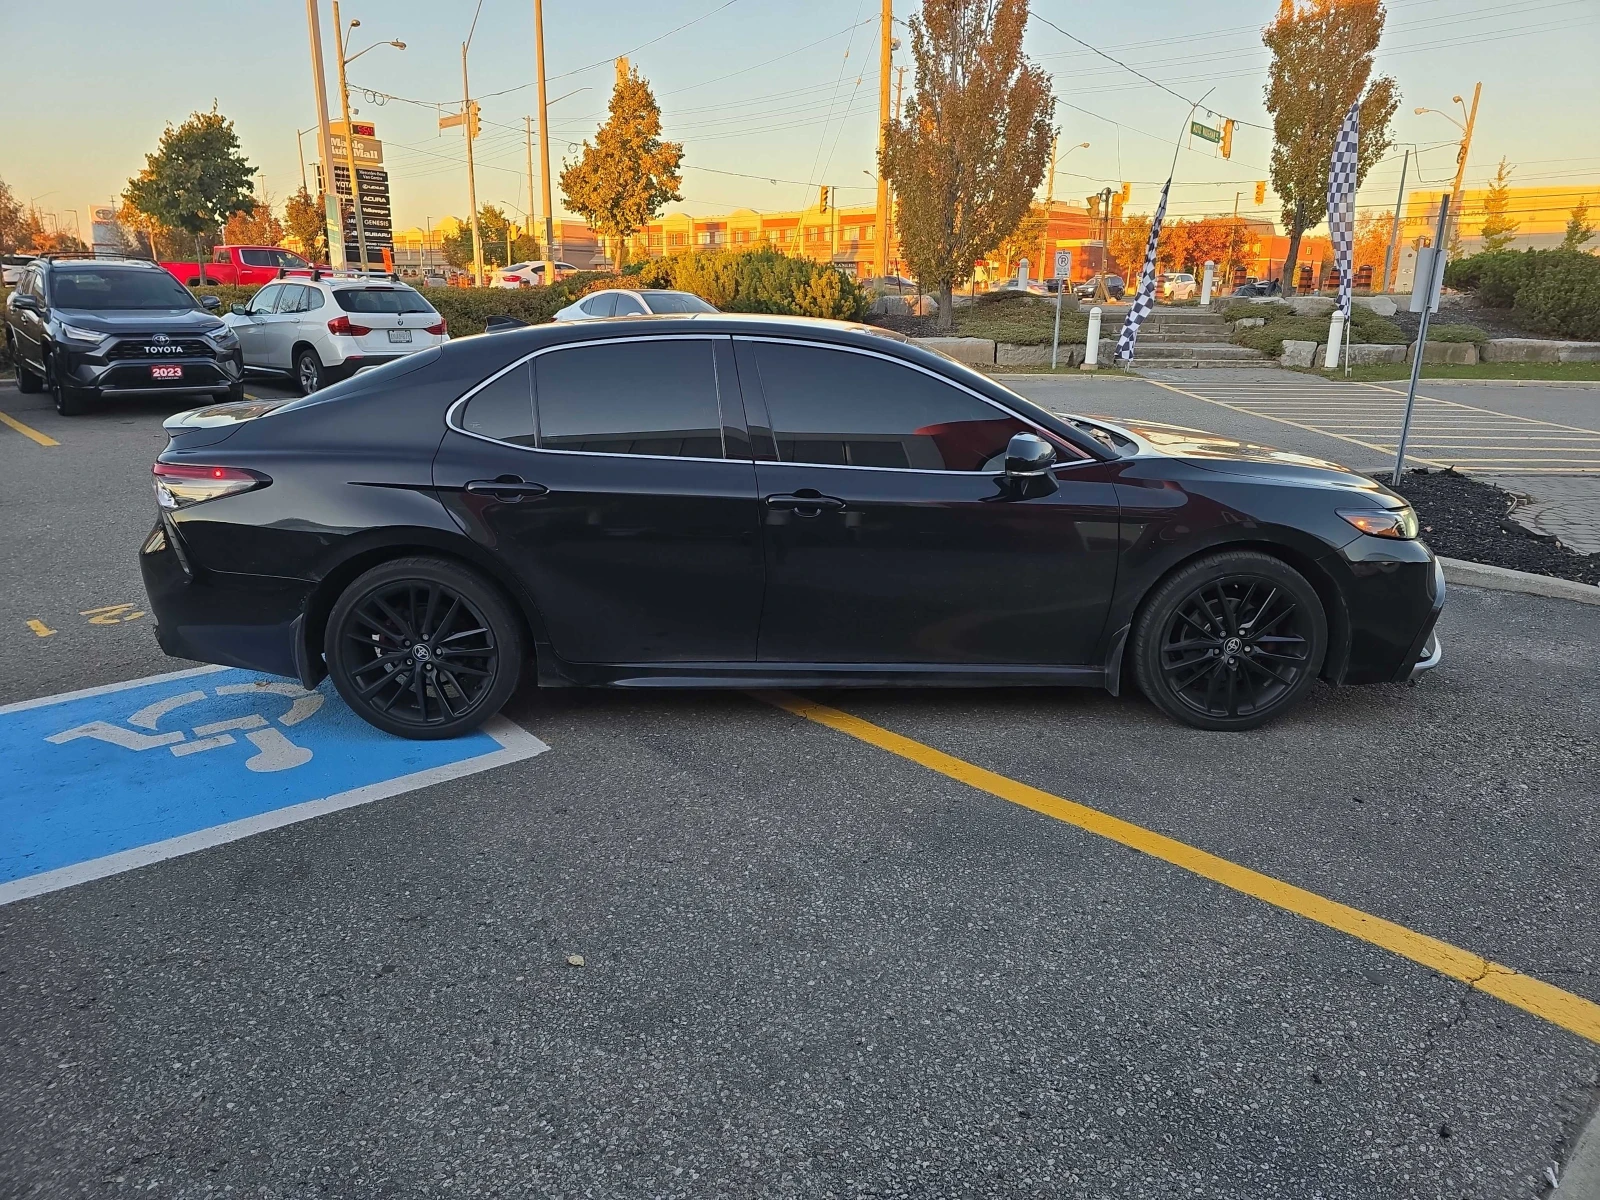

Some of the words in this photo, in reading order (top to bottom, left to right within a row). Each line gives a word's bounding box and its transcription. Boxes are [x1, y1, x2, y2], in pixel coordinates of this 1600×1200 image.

[353, 148, 378, 159] Mall
[364, 219, 389, 227] GENESIS
[152, 368, 182, 377] 2023
